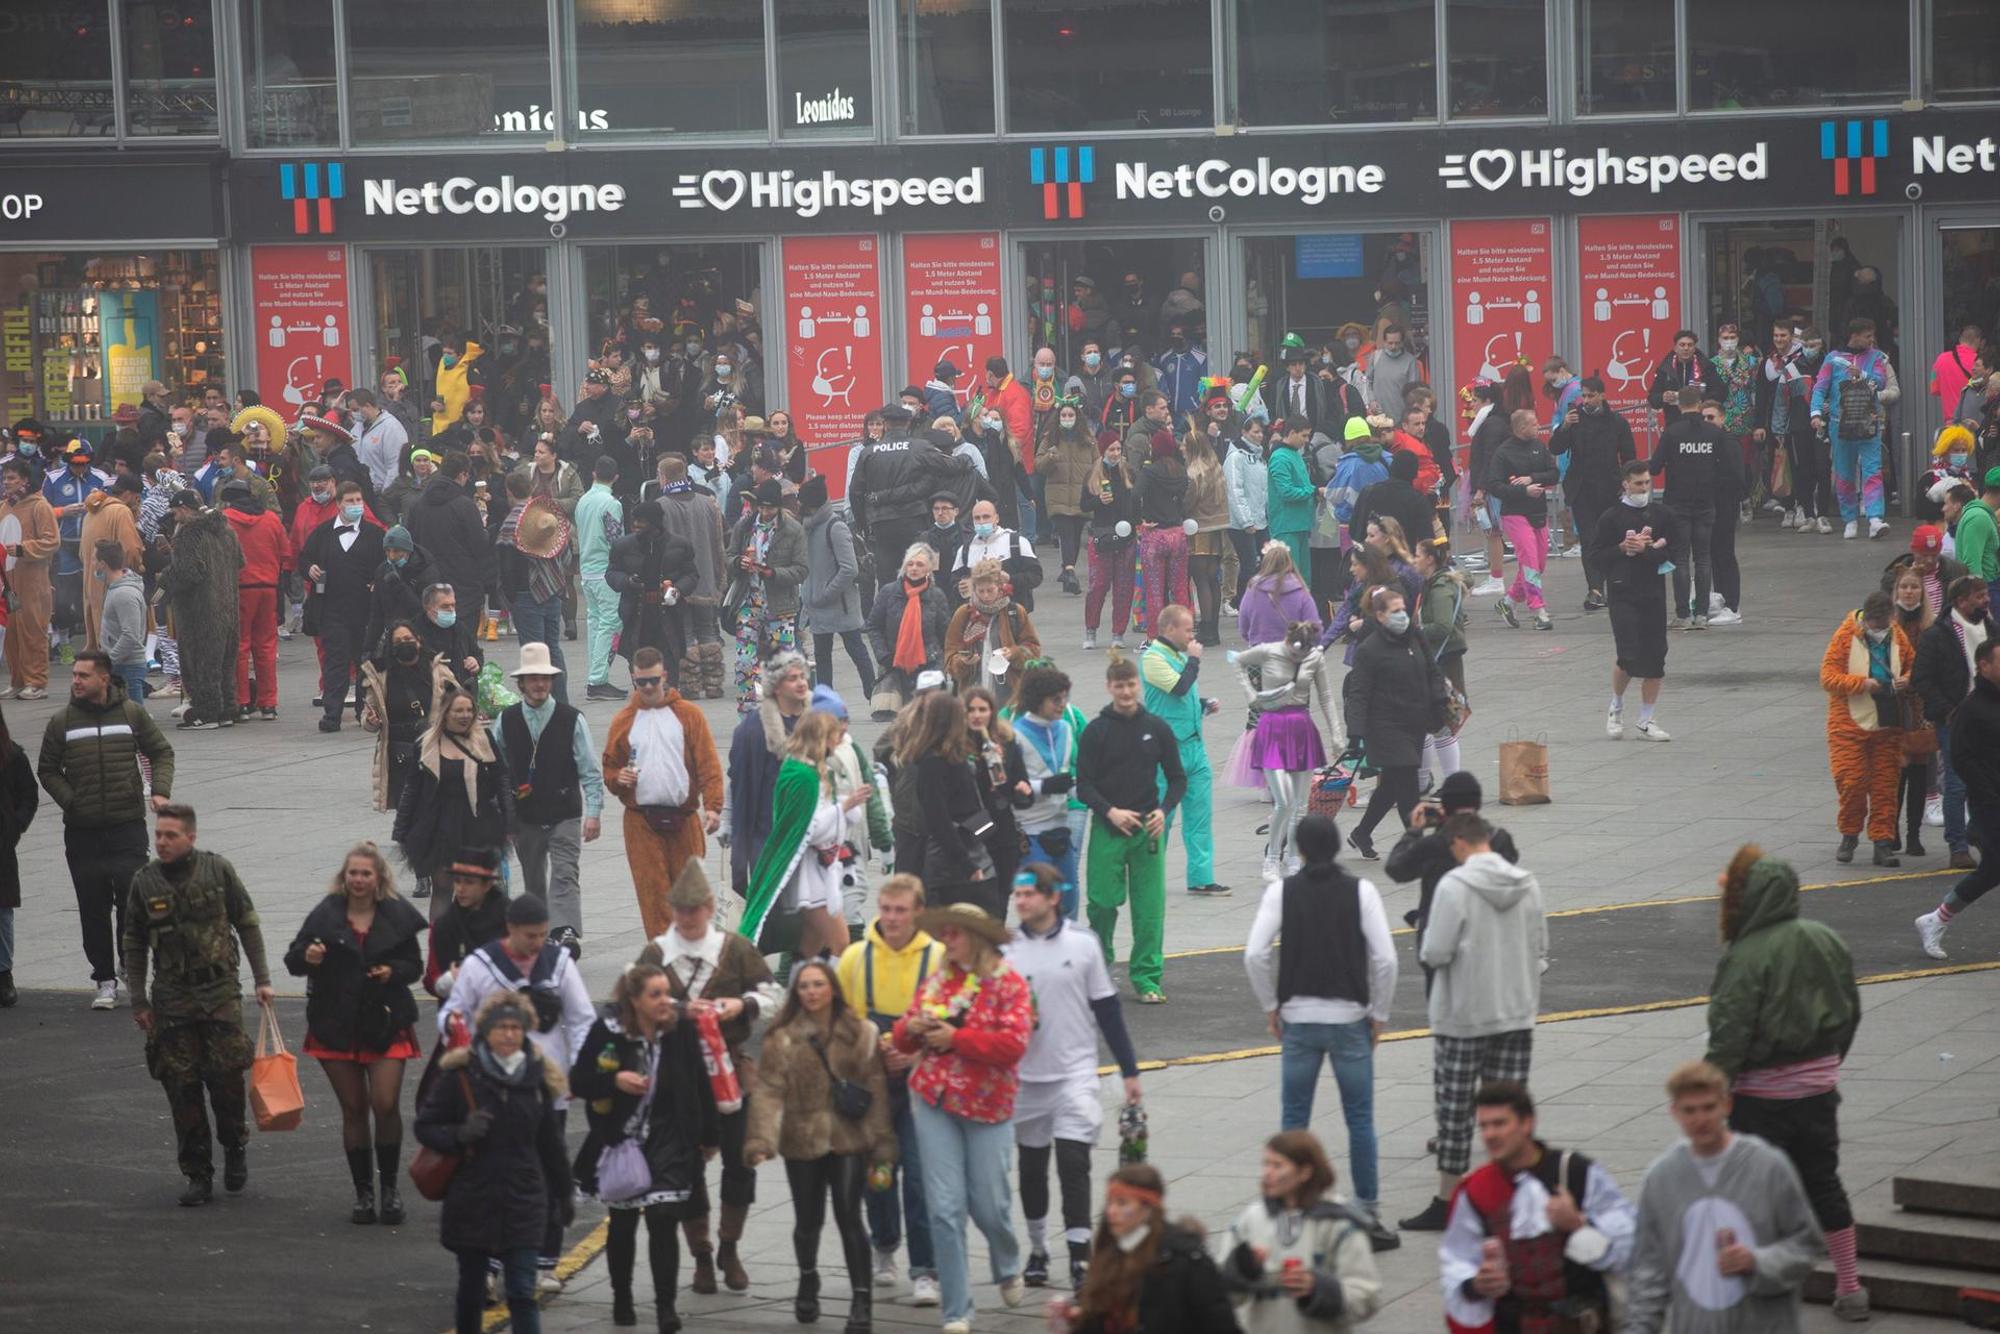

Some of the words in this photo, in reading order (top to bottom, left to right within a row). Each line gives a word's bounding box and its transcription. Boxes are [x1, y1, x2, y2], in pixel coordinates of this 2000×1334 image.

[796, 87, 854, 124] Leonidas
[1115, 156, 1386, 205] NetCologne
[1521, 142, 1769, 197] Highspeed
[2, 194, 43, 219] OP
[364, 175, 626, 222] NetCologne
[750, 167, 985, 218] Highspeed
[3, 305, 32, 371] REFILL
[827, 413, 843, 421] keep
[873, 441, 910, 453] POLICE
[1679, 442, 1713, 454] POLICE
